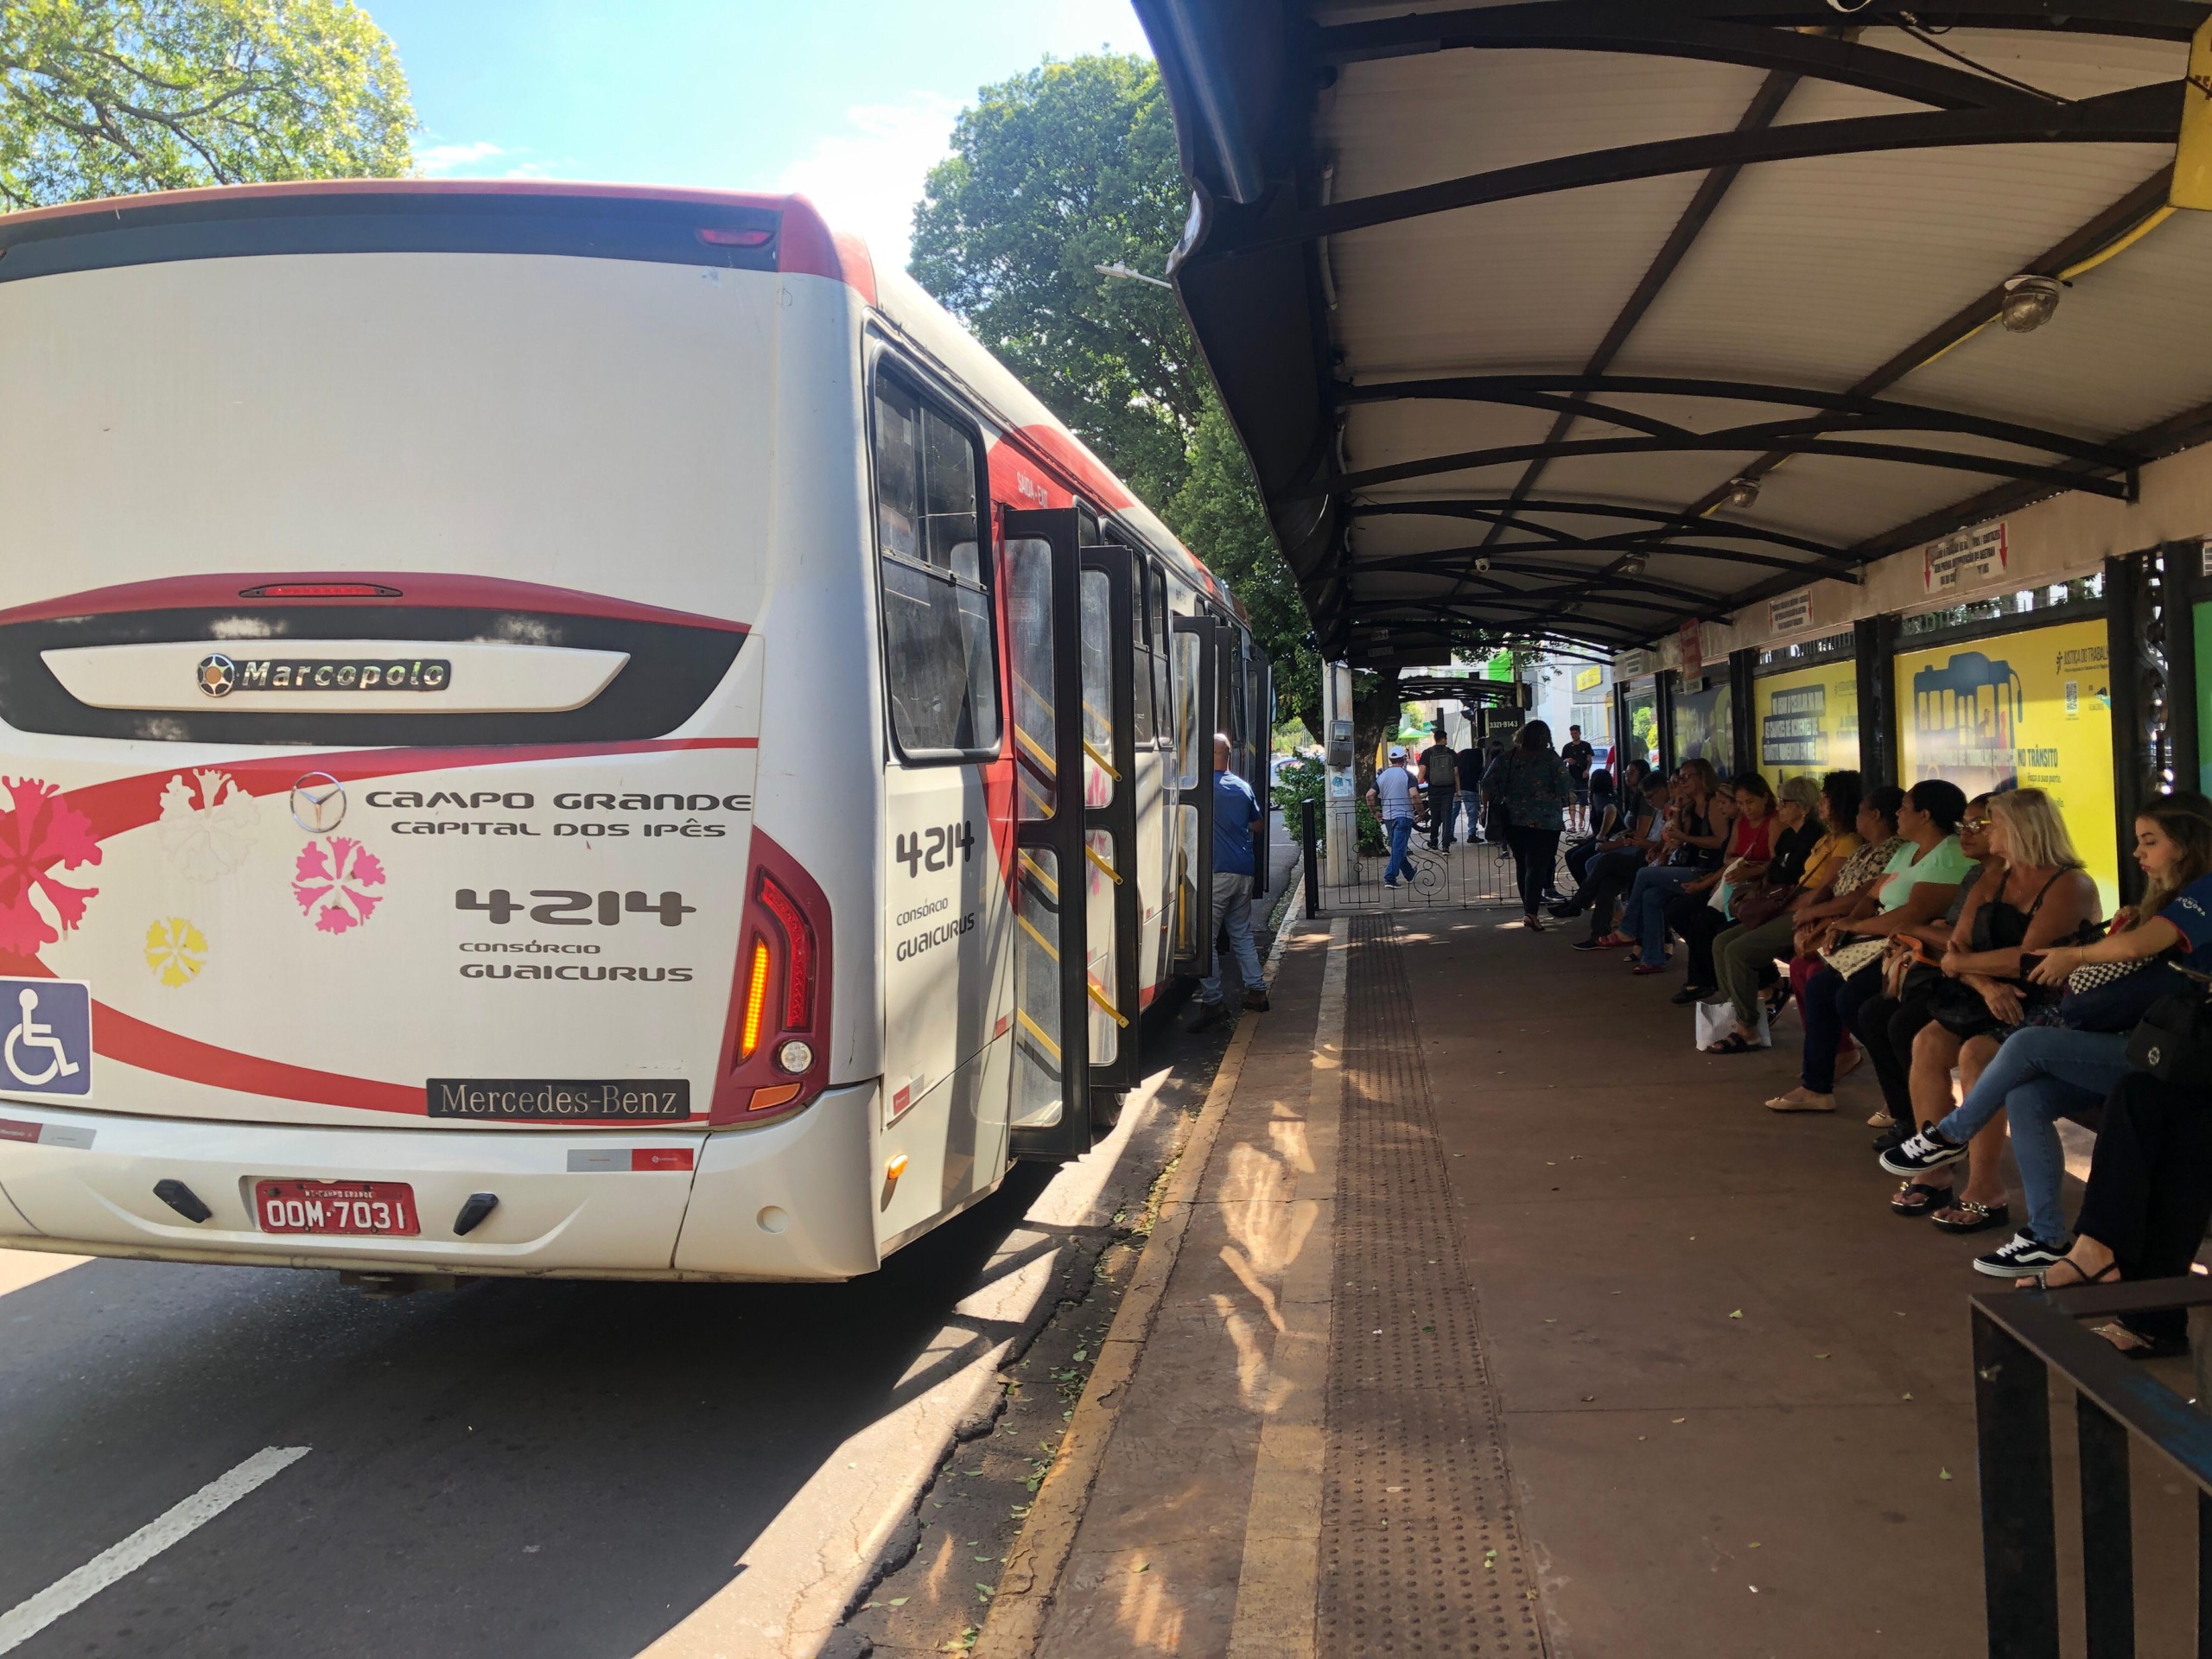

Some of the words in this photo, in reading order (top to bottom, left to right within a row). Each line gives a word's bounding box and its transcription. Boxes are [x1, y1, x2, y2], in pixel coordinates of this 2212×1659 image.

[1016, 469, 1035, 501] SAÍDA
[1037, 485, 1048, 510] EXIT
[242, 661, 444, 690] Marcopolo
[2018, 748, 2027, 766] NO
[2028, 744, 2058, 767] TRÂNSITO
[365, 791, 535, 810] CAMPO
[553, 792, 752, 811] GRANDE
[391, 822, 541, 836] CAPITAL
[553, 823, 630, 836] DOS
[644, 817, 726, 837] IPÊS
[896, 820, 975, 879] 4214
[455, 888, 697, 927] 4214
[897, 897, 949, 926] CONSÓRCIO
[459, 939, 601, 954] CONSÓRCIO
[896, 912, 975, 962] GUAICURUS
[460, 963, 693, 982] GUAICURUS
[440, 1084, 677, 1115] Mercedes-Benz
